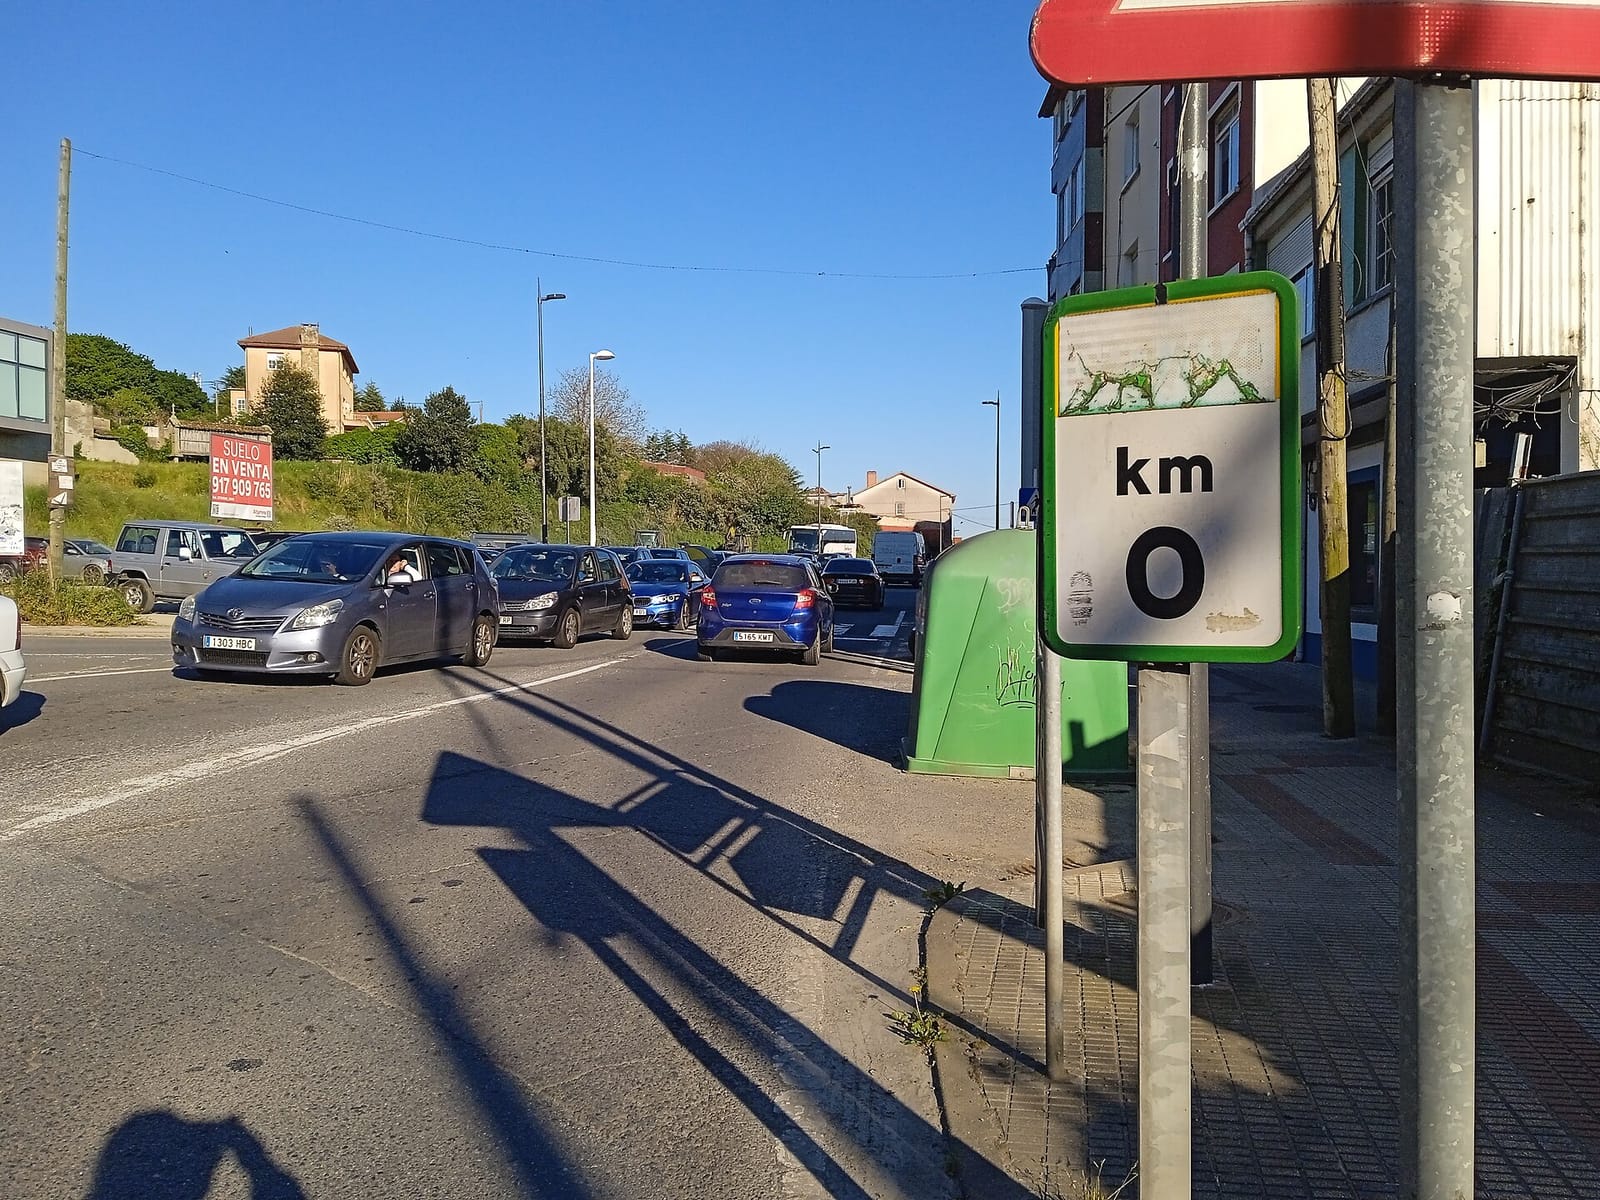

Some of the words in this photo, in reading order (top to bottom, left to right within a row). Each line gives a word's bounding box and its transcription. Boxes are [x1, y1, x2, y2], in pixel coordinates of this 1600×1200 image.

[223, 440, 260, 461] SUELO
[212, 457, 229, 474] EN
[231, 460, 270, 480] VENTA
[1117, 447, 1212, 496] km
[212, 476, 230, 494] 917
[232, 478, 251, 497] 909
[254, 481, 271, 499] 765
[212, 638, 233, 648] 1303
[235, 639, 253, 649] HBC
[738, 632, 757, 641] 5165
